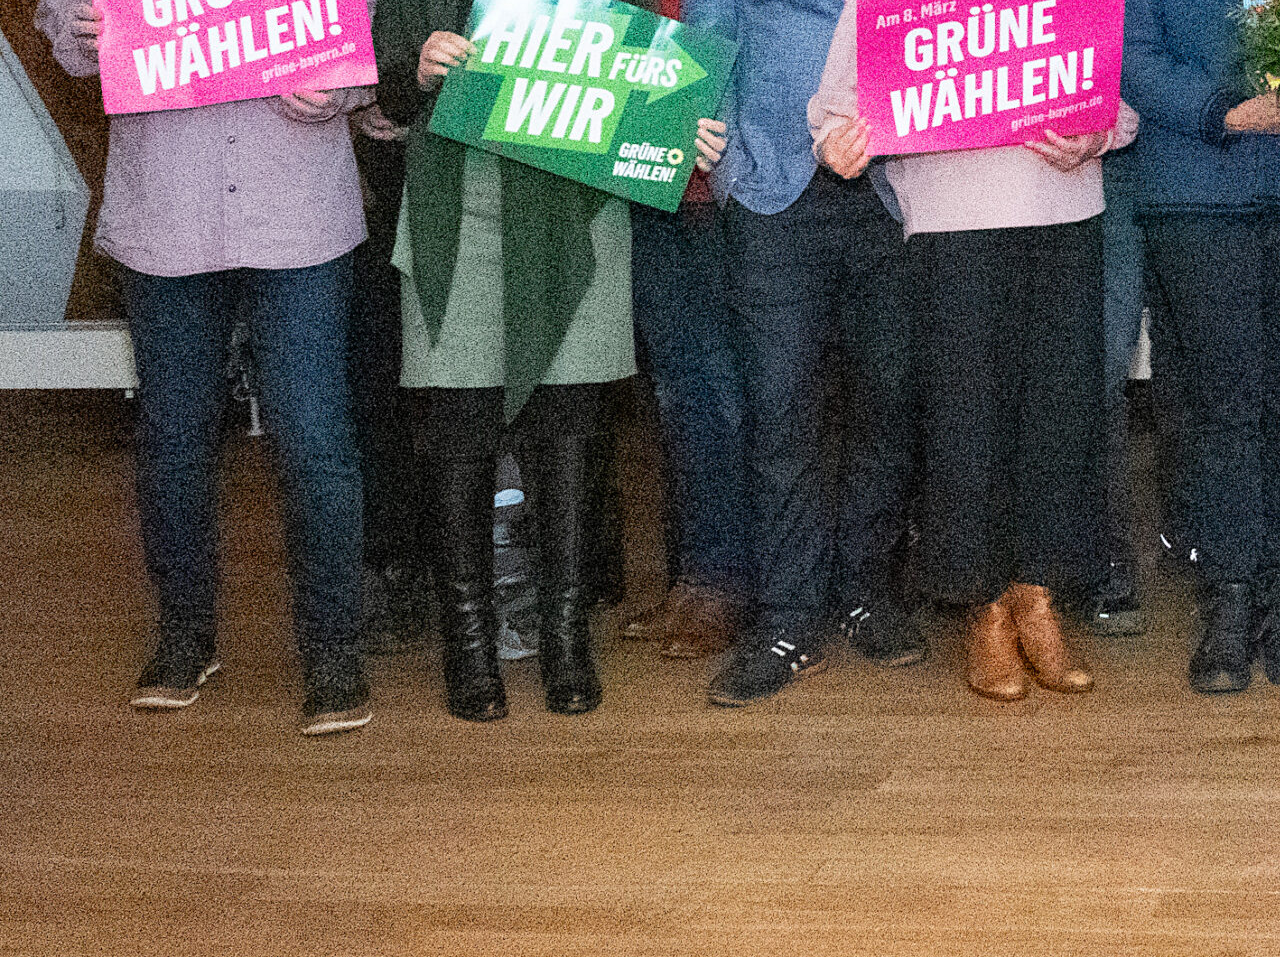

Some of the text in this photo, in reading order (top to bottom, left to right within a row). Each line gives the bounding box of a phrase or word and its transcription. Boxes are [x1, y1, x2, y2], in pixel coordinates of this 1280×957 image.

[876, 0, 957, 29] Am 8. März
[262, 41, 356, 83] grüne-bayern.de
[480, 13, 682, 87] HIER FÜRS
[504, 77, 616, 144] WIR
[890, 47, 1095, 138] WÄHLEN!
[1011, 95, 1104, 132] grüne-bayern.de
[612, 161, 677, 183] WÄHLEN!
[618, 142, 668, 163] GRÜNE
